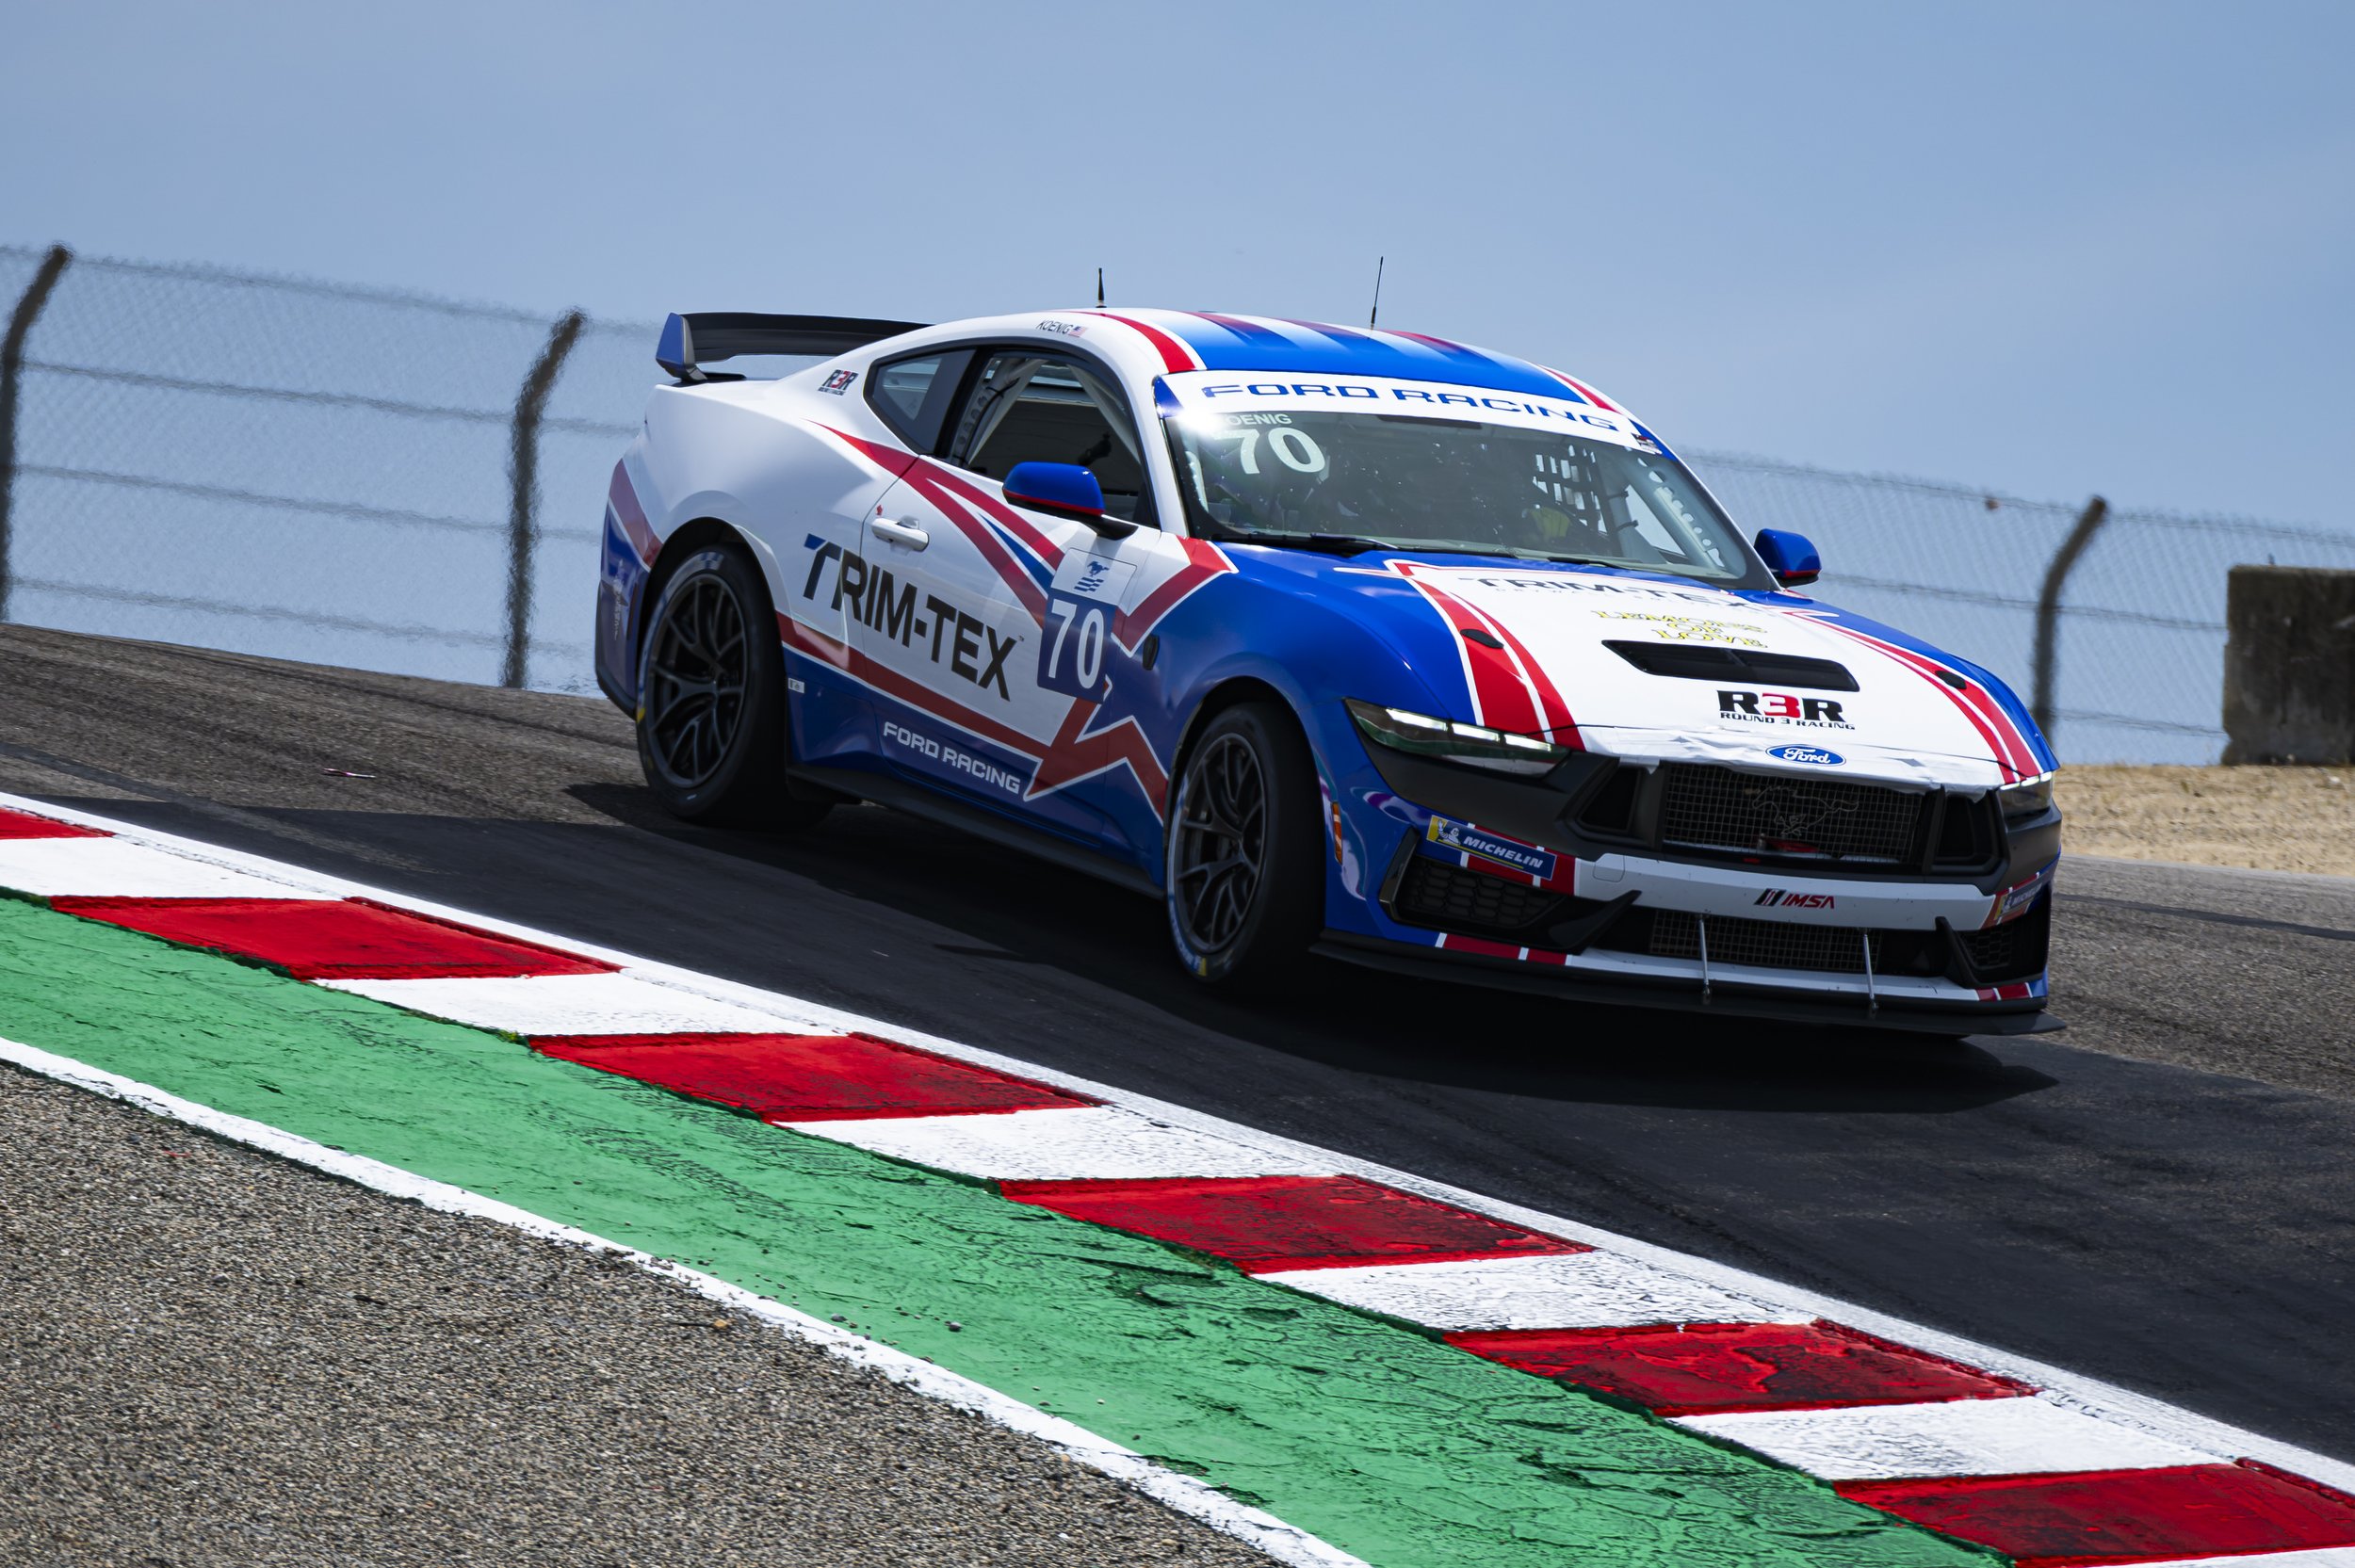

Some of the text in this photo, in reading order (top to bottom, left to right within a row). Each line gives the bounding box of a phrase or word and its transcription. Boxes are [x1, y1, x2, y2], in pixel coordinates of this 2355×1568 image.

[1036, 320, 1073, 334] KOENIG
[821, 369, 858, 391] R3R
[1201, 383, 1618, 432] FORD RACING
[1226, 413, 1292, 425] OENIG
[1213, 427, 1325, 473] 70
[1457, 577, 1766, 613] TRIM-TEX
[804, 533, 1017, 702] TRIM-TEX
[1048, 598, 1104, 689] 70
[1651, 629, 1768, 649] LOVE
[1716, 690, 1846, 722] R3R
[1720, 712, 1856, 731] ROUND 3 RACING
[883, 721, 1021, 795] FORD RACING
[1784, 747, 1831, 764] Ford
[1463, 835, 1544, 868] MICHELIN
[1780, 893, 1834, 910] IMSA
